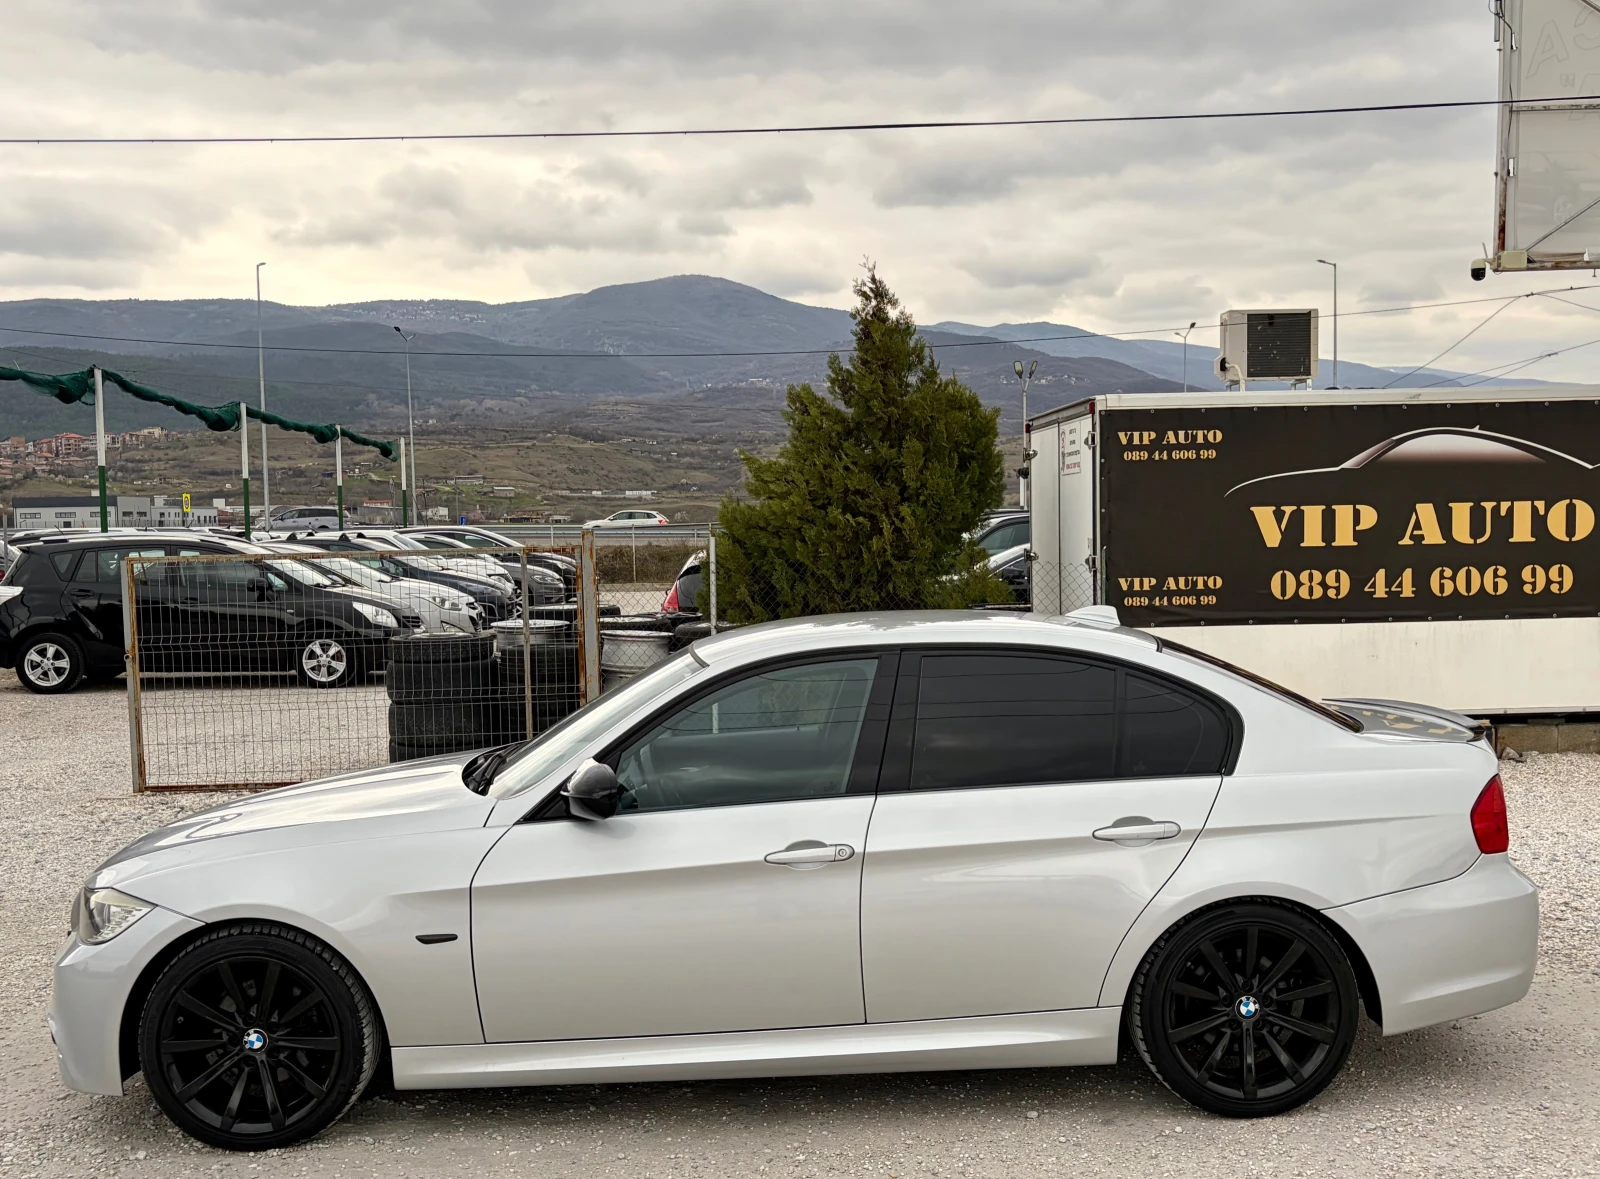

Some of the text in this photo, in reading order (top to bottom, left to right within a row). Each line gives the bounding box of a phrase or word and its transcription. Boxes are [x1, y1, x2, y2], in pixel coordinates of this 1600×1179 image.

[1117, 429, 1223, 446] VIP AUTO
[1123, 448, 1217, 461] 089 44 606 99
[1249, 498, 1596, 549] VIP AUTO
[1118, 575, 1223, 591] VIP AUTO
[1270, 563, 1574, 601] 089 44 606 99
[1124, 594, 1217, 607] 089 44 606 99
